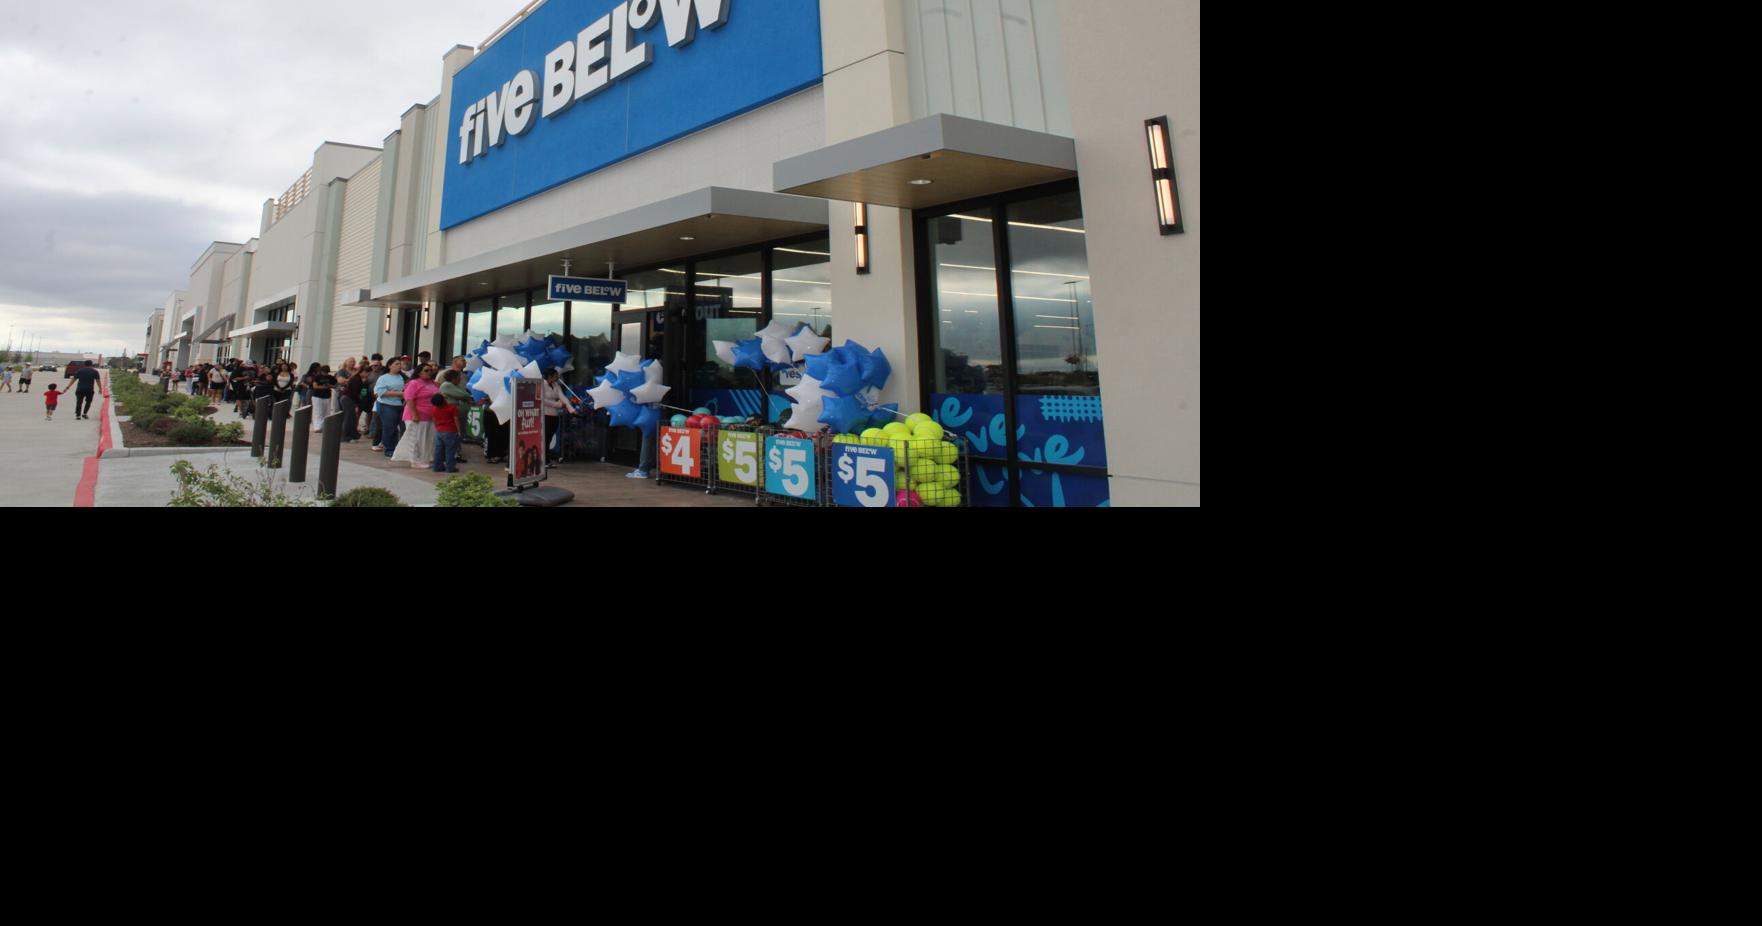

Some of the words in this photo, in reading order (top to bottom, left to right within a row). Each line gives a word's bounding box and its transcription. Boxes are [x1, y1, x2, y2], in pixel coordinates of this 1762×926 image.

[459, 69, 540, 165] five
[555, 283, 582, 294] five
[467, 410, 480, 437] $5
[661, 432, 694, 475] $4
[722, 437, 757, 484] $5
[769, 445, 809, 496] $5
[837, 453, 889, 508] $5
